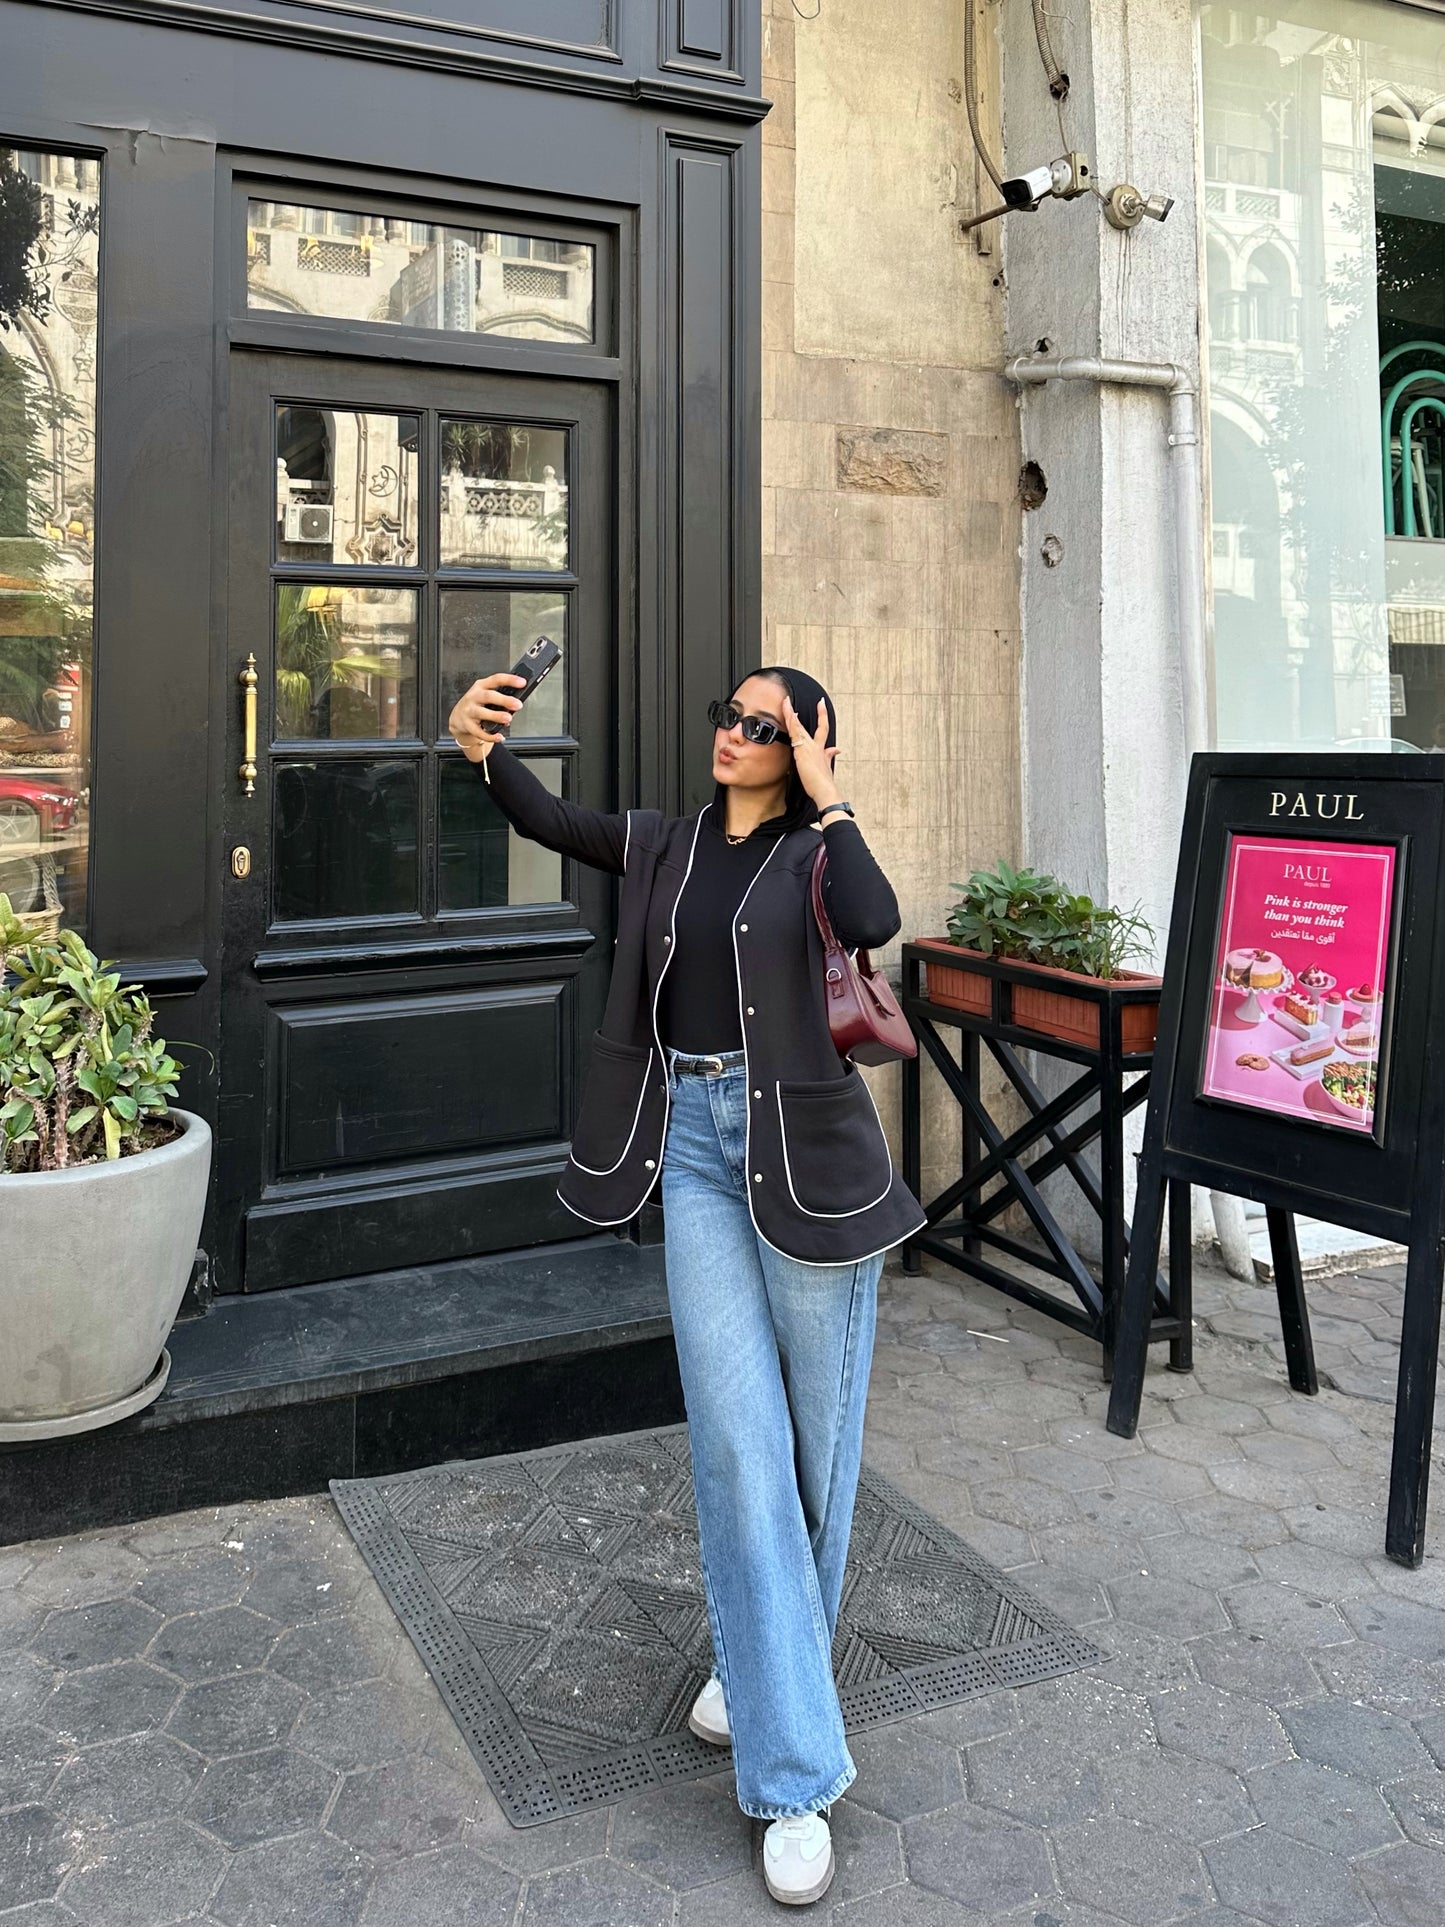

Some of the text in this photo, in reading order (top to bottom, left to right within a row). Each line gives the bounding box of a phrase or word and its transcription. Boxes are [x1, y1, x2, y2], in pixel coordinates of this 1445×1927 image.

[1269, 792, 1364, 820] PAUL
[1284, 864, 1331, 882] PAUL
[1264, 894, 1348, 915] Pink is stronger
[1264, 909, 1345, 928] than you think
